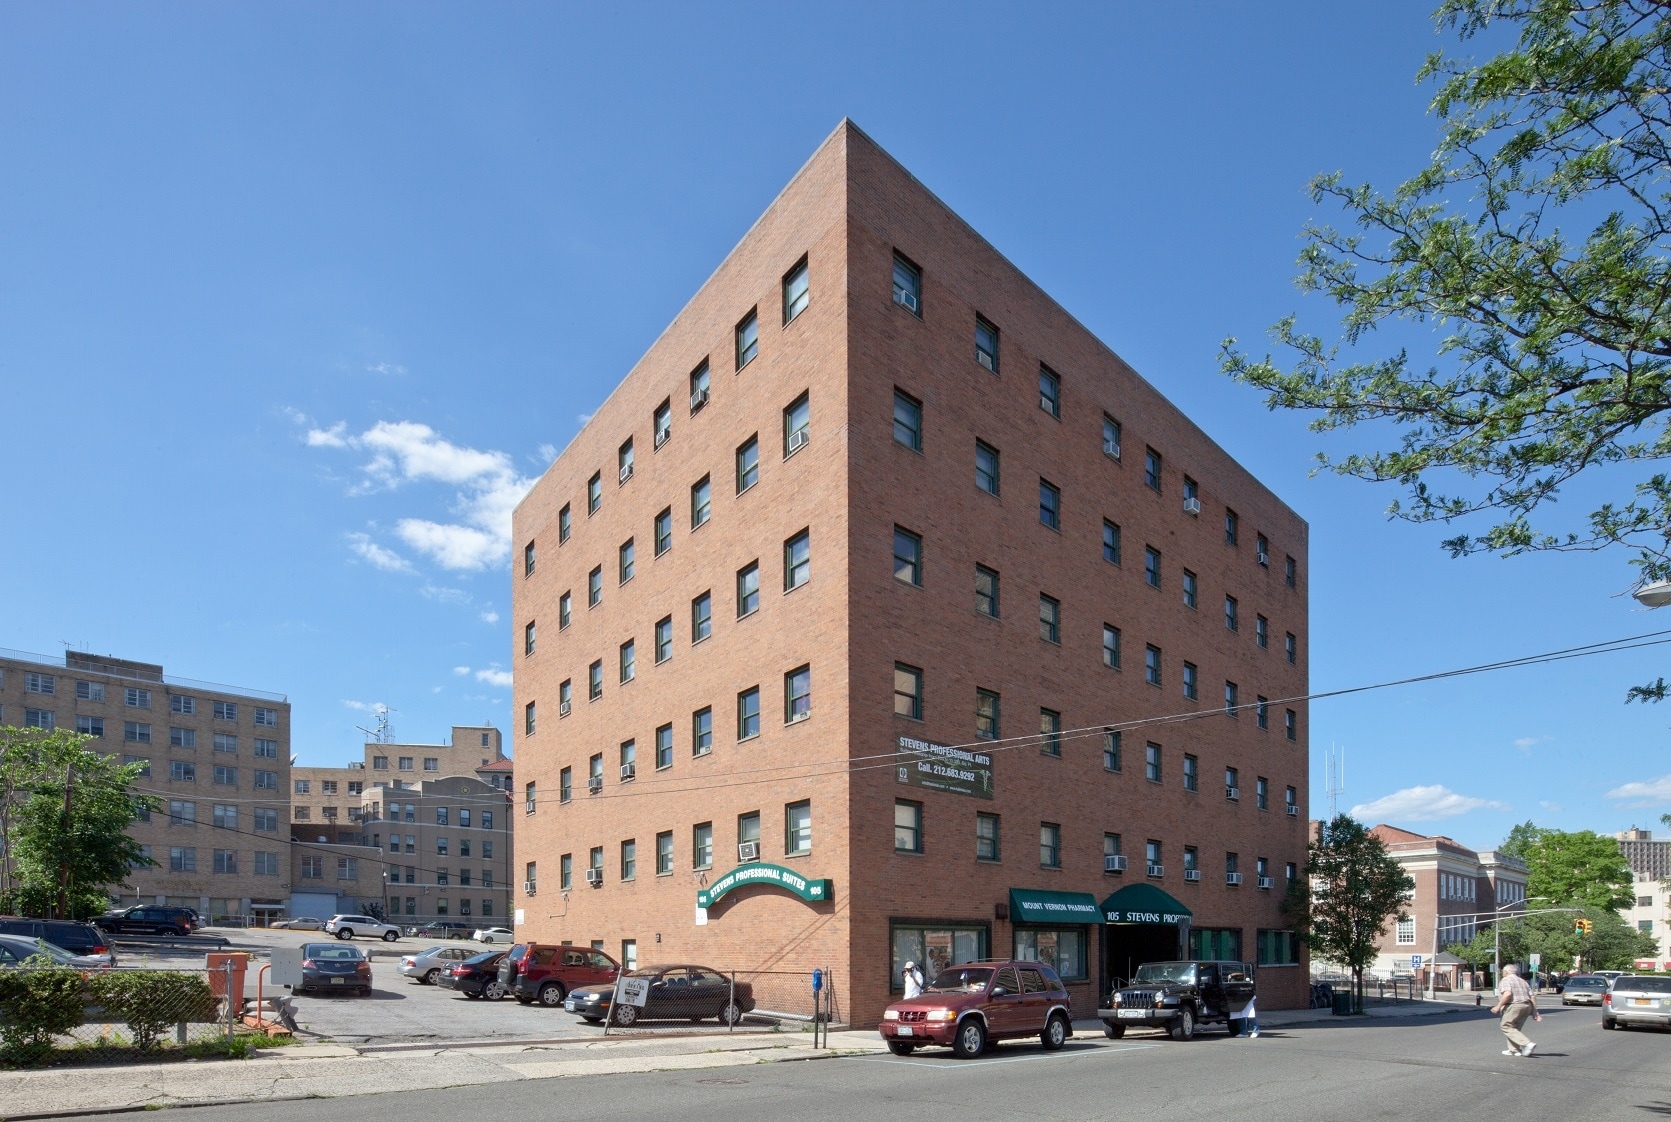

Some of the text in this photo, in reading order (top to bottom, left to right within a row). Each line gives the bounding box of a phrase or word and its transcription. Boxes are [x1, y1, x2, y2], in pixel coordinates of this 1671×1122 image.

[900, 736, 929, 751] STEVENS
[930, 744, 974, 762] PROFESSIONAL
[975, 754, 990, 766] ARTS
[933, 765, 975, 781] 212.683.9292
[710, 868, 806, 897] STEVENS PROFESSIONAL SUITES
[810, 886, 821, 895] 105
[1022, 901, 1096, 912] MOUNT VERNON PHARMACY
[1106, 911, 1119, 921] 105
[1126, 911, 1160, 923] STEVENS
